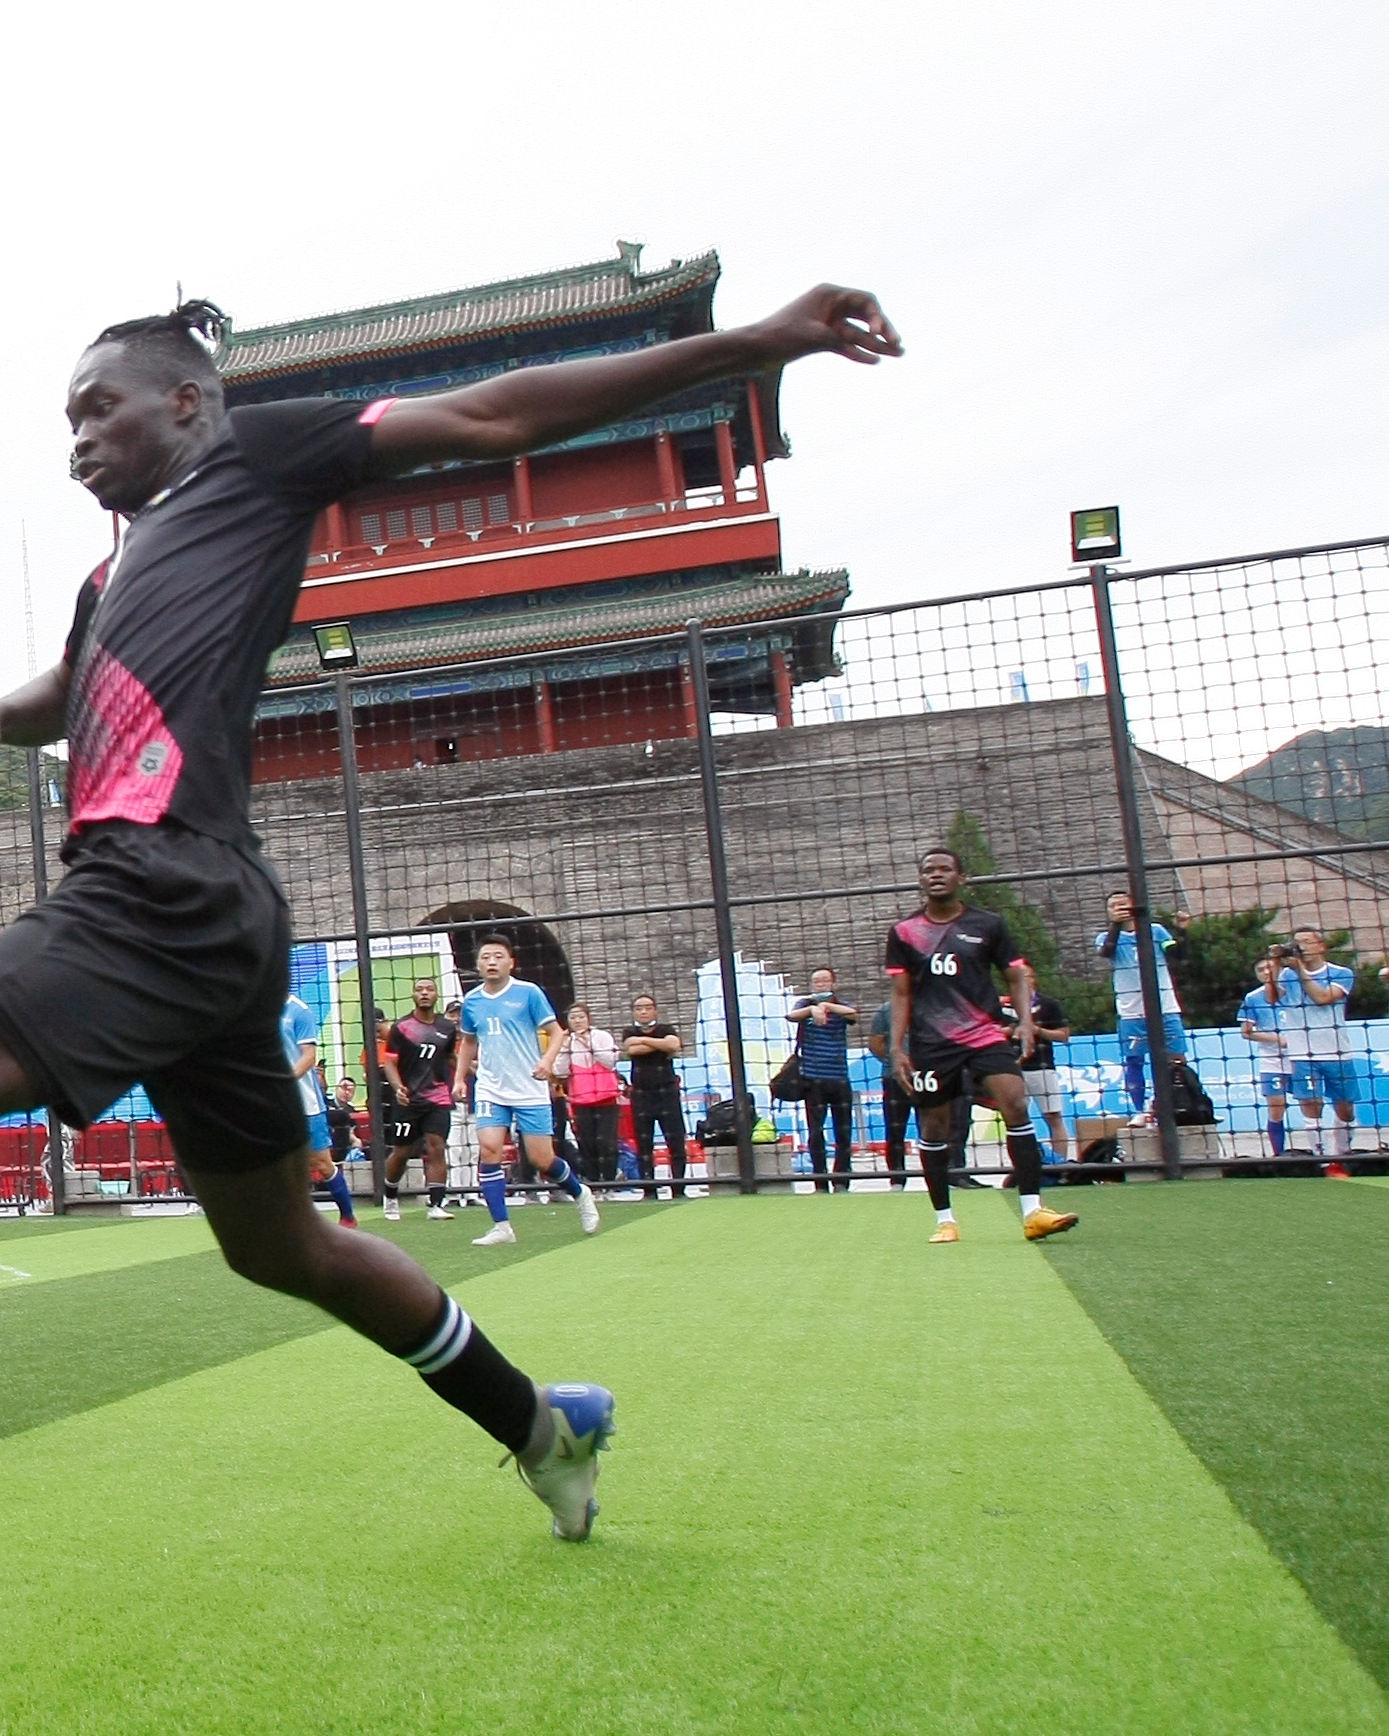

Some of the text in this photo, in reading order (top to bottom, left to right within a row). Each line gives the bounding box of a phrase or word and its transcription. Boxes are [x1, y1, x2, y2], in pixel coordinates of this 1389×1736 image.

[930, 953, 958, 976] 66
[486, 1016, 502, 1036] 11
[419, 1043, 437, 1060] 77
[912, 1070, 939, 1093] 66
[476, 1101, 493, 1118] 11
[394, 1122, 411, 1137] 77
